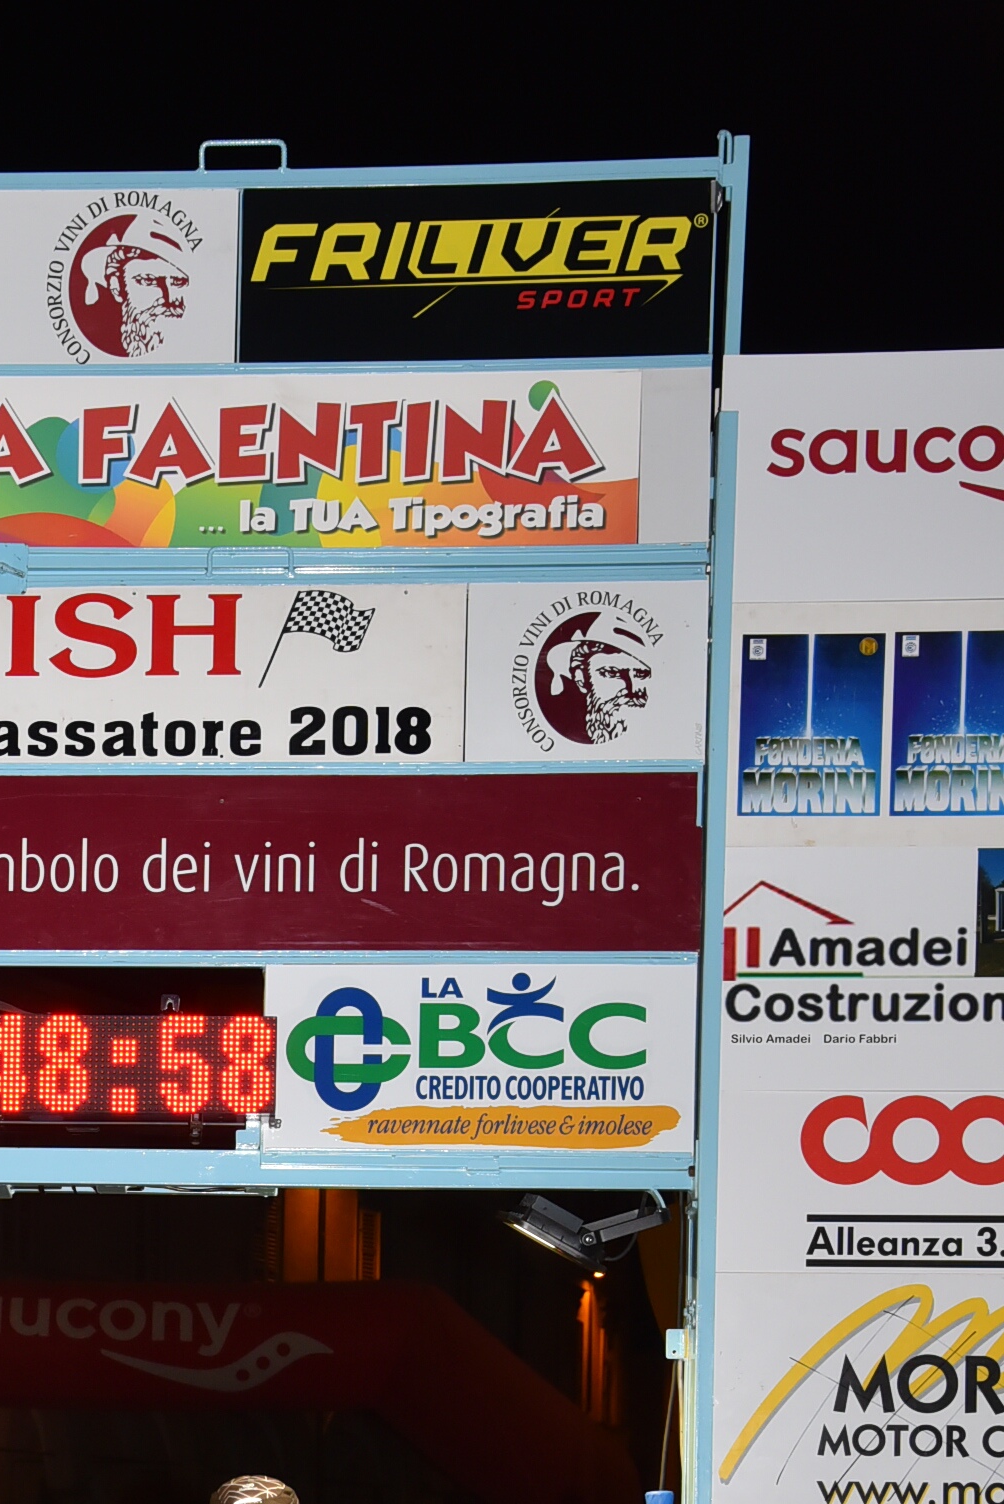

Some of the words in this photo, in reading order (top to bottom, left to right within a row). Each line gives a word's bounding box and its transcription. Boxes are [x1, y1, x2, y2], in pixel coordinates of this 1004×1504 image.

[84, 195, 109, 217] DI
[112, 190, 204, 254] ROMAGNA
[52, 210, 89, 254] VINI
[250, 213, 692, 283] FRILIVER
[45, 259, 91, 364] CONSORZIO
[516, 288, 641, 310] SPORT
[77, 388, 606, 487] FAENTINA
[766, 424, 1004, 478] sauco
[239, 501, 276, 534] la
[289, 496, 379, 533] TUA
[388, 495, 605, 538] Tipografia
[521, 611, 553, 648] VINI
[551, 598, 574, 618] DI
[576, 590, 664, 648] ROMAGNA
[511, 653, 555, 753] CONSORZIO
[288, 705, 433, 756] 2018
[755, 735, 865, 767] FONDERIA
[741, 766, 877, 815] MORINI
[142, 837, 211, 893] dei
[234, 841, 317, 893] vini
[339, 837, 379, 893] di
[404, 842, 641, 907] Romagna.
[769, 927, 968, 967] Amadei
[421, 977, 464, 999] LA
[418, 1002, 648, 1070] BCC
[731, 1033, 764, 1045] Silvio
[766, 1033, 811, 1045] Amadei
[823, 1033, 856, 1045] Dario
[859, 1033, 898, 1045] Fabbri
[415, 1075, 501, 1101] CREDITO
[506, 1075, 645, 1102] COOPERATIVO
[366, 1113, 471, 1136] ravennate
[469, 1113, 556, 1141] forlivese
[559, 1116, 574, 1136] &
[578, 1114, 653, 1137] imolese
[806, 1225, 964, 1258] Alleanza
[833, 1353, 1004, 1415] MOR
[817, 1423, 970, 1459] MOTOR
